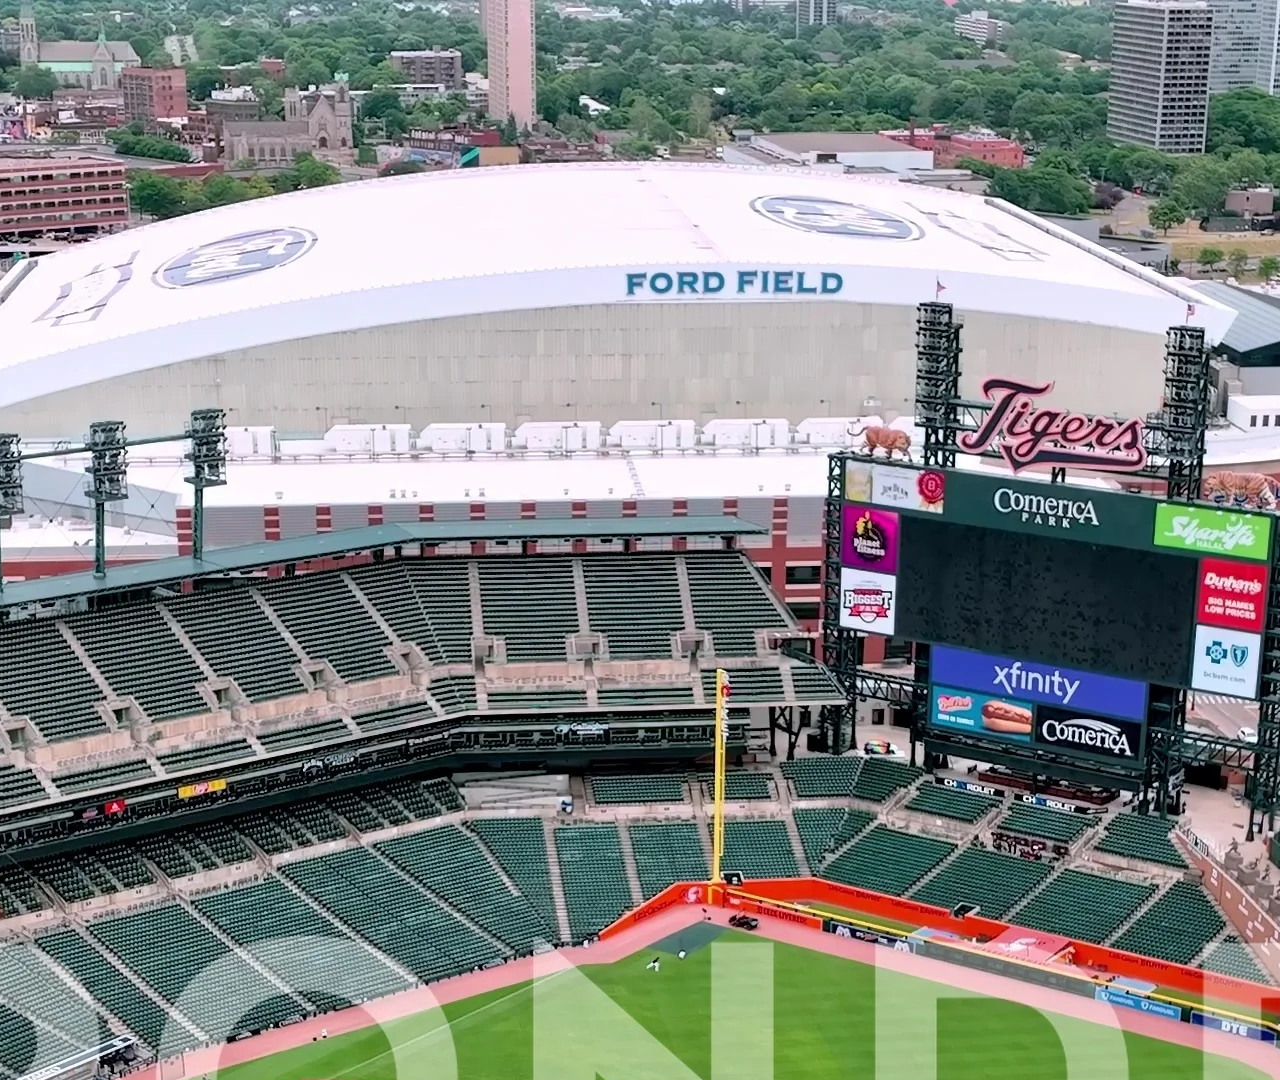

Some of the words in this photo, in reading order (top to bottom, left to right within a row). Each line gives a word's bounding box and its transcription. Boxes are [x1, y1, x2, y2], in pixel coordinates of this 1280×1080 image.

[625, 270, 725, 296] FORD
[736, 270, 844, 296] FIELD
[960, 376, 1147, 472] Tigers
[1021, 512, 1071, 529] PARK
[1204, 572, 1263, 594] Dunham's
[1204, 605, 1225, 616] LOW
[1225, 607, 1257, 620] PRICES
[1207, 597, 1224, 608] BIG
[1224, 599, 1255, 612] NAMES
[992, 661, 1081, 705] xfinity
[1202, 670, 1246, 684] bcbsm.com
[1220, 1020, 1248, 1037] DTE
